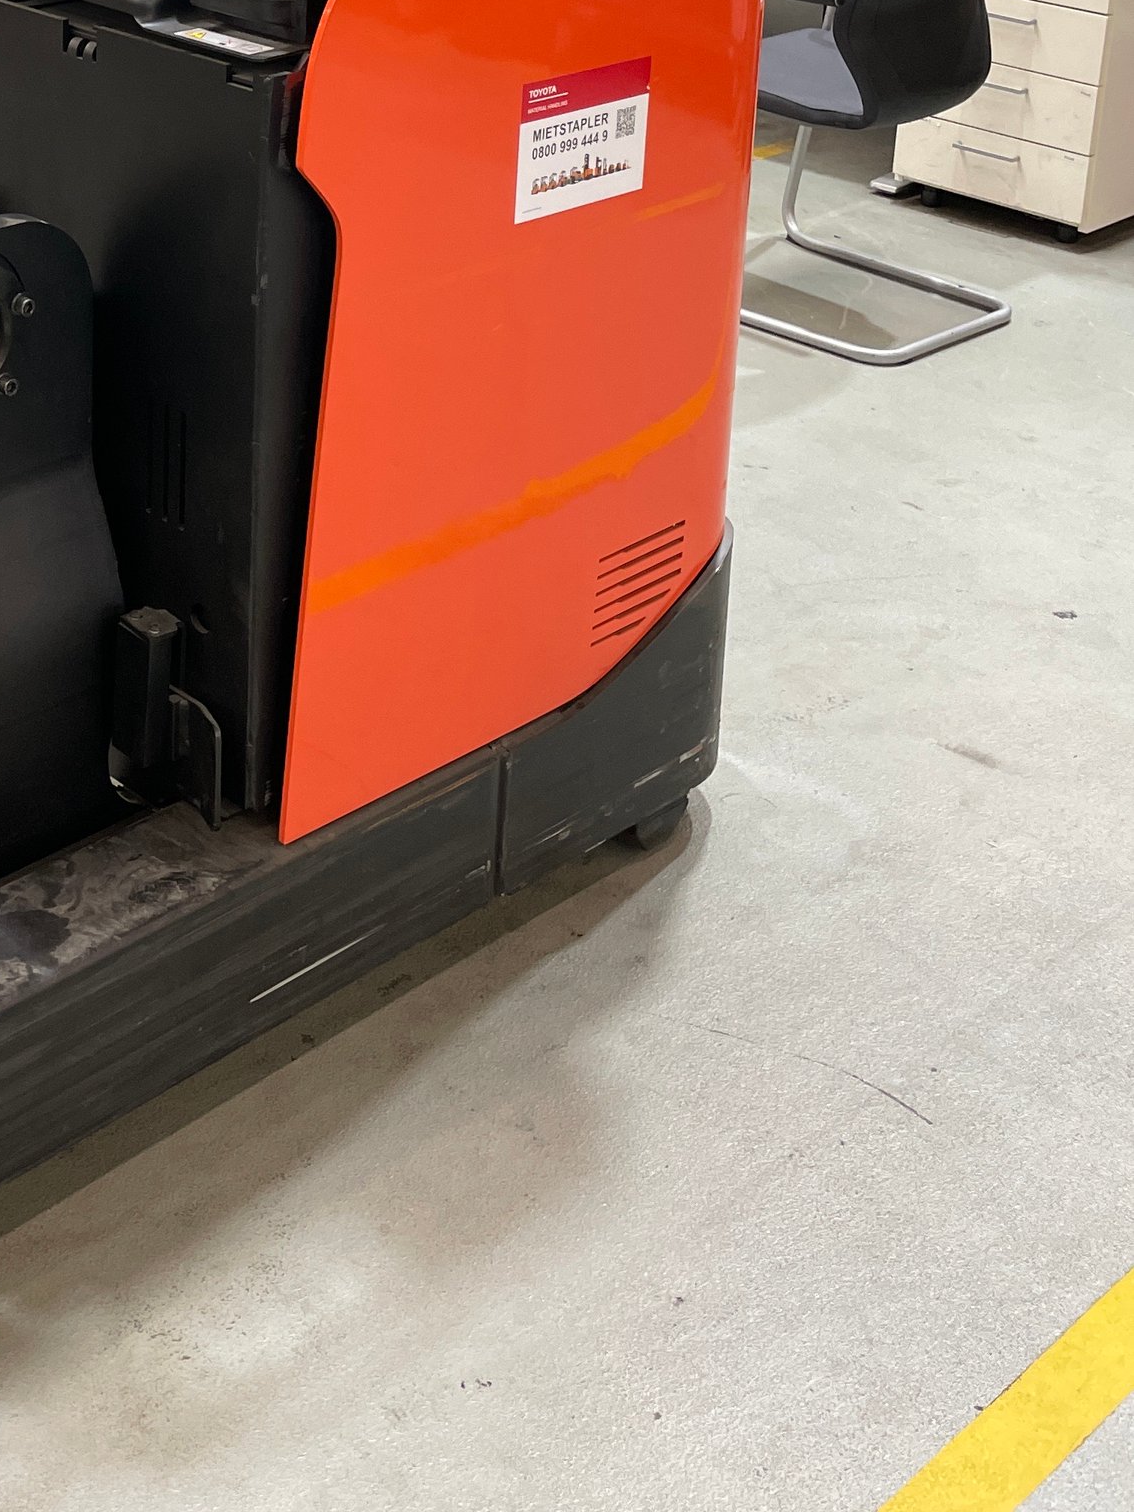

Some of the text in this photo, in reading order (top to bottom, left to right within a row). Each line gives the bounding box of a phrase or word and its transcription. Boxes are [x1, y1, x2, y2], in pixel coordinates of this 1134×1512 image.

[529, 85, 557, 98] TOYOTA
[532, 112, 609, 142] MIETSTAPLER
[532, 130, 608, 160] 0800 999 444 9
